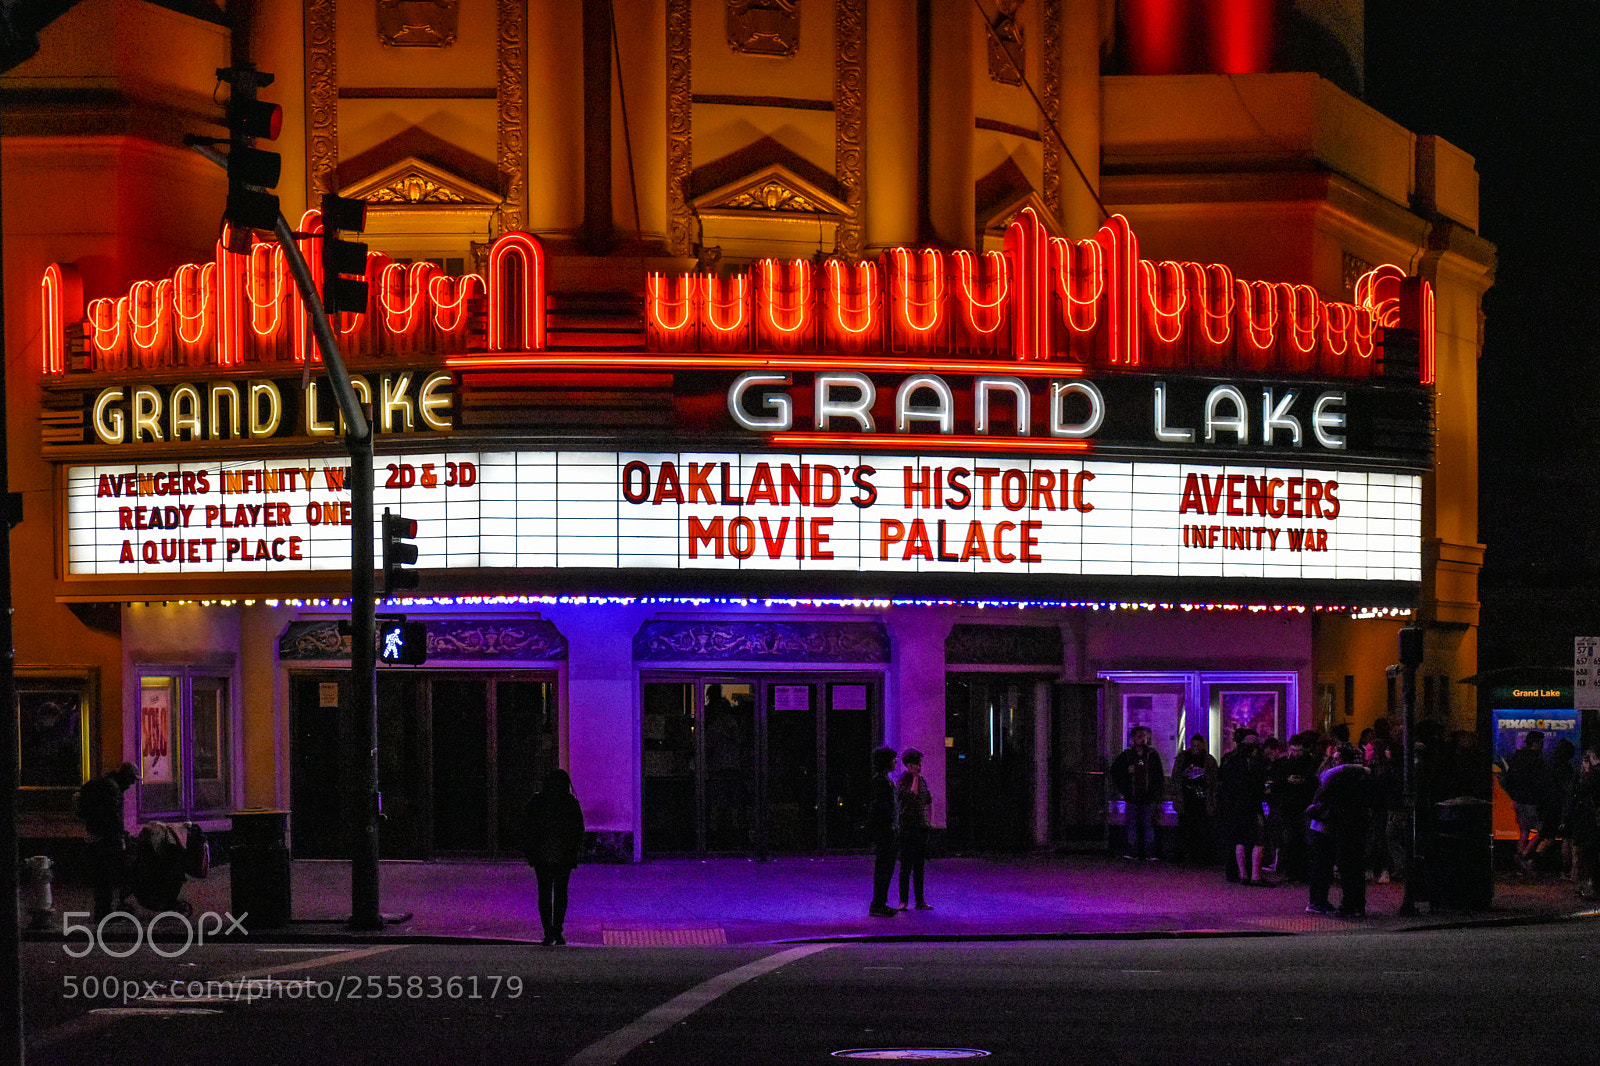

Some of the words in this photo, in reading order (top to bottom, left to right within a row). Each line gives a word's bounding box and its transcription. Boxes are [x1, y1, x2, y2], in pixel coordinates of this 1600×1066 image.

[93, 378, 281, 444] GRAND
[727, 371, 1106, 439] GRAND
[1154, 382, 1347, 449] LAKE
[97, 470, 210, 498] AVENGERS
[219, 466, 315, 495] INFINITY
[385, 464, 415, 489] 2D
[420, 462, 438, 488] &
[445, 461, 478, 487] 3D
[622, 460, 877, 508] OAKLAND'S
[904, 465, 1096, 513] HISTORIC
[1179, 472, 1340, 520] AVENGERS
[118, 503, 194, 530] READY
[205, 501, 291, 528] PLAYER
[306, 501, 352, 526] ONE
[119, 540, 134, 563] A
[143, 538, 217, 562] QUIET
[226, 536, 303, 561] PLACE
[688, 515, 835, 561] MOVIE
[880, 518, 1043, 564] PALACE
[1183, 524, 1280, 551] INFINITY
[1287, 528, 1328, 552] WAR
[1513, 689, 1539, 697] Grand
[1540, 689, 1561, 697] Lake
[1498, 719, 1536, 729] PIXAR
[1543, 720, 1576, 730] FEST
